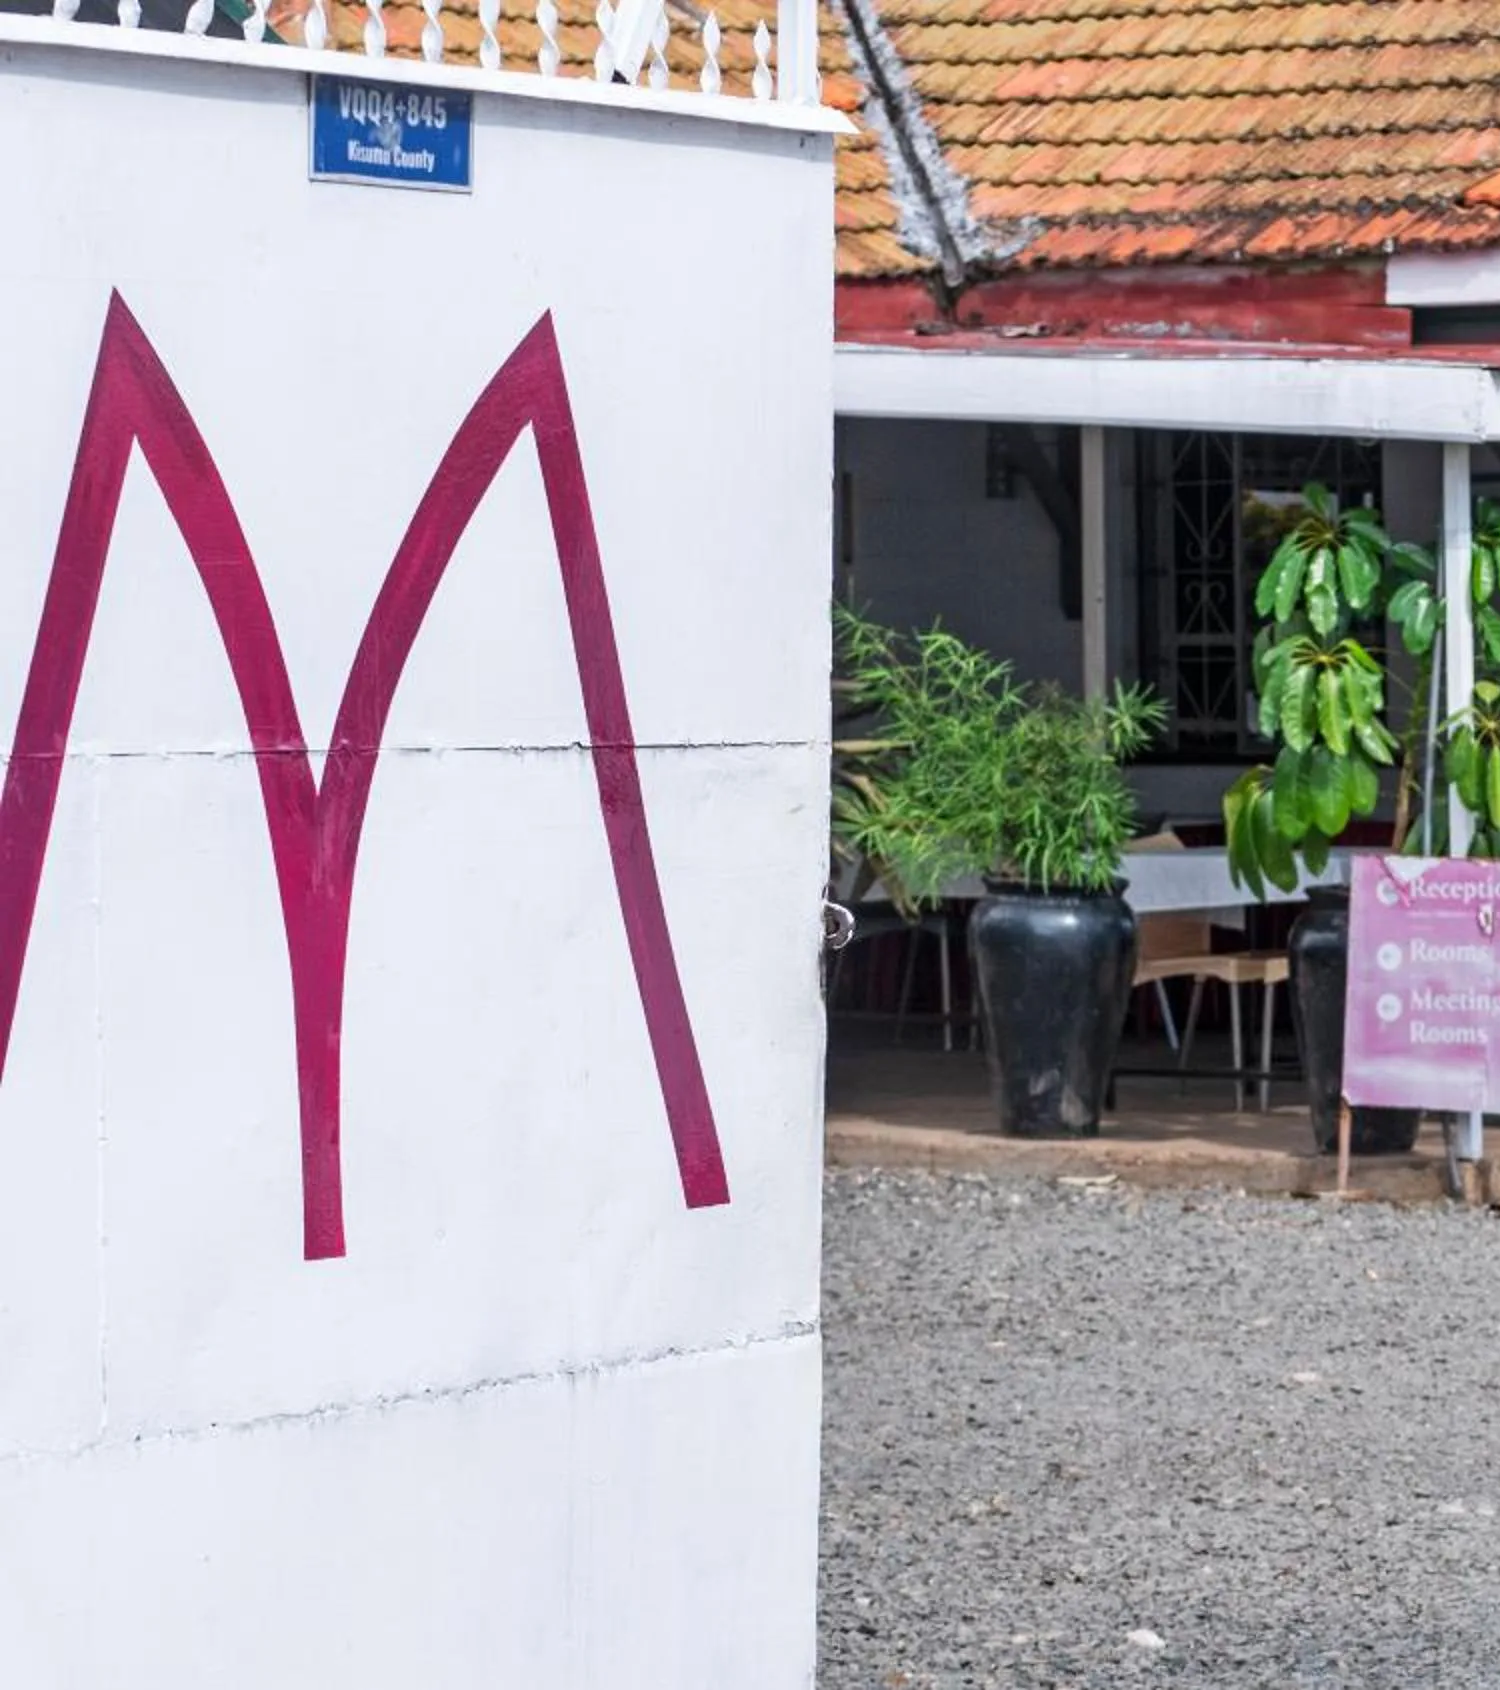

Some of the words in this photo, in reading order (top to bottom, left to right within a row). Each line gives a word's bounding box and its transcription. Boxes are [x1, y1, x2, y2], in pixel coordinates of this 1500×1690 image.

[339, 85, 446, 129] VQQ4+845
[393, 146, 435, 173] County
[1410, 938, 1492, 961] Rooms
[1410, 1020, 1488, 1044] Rooms
